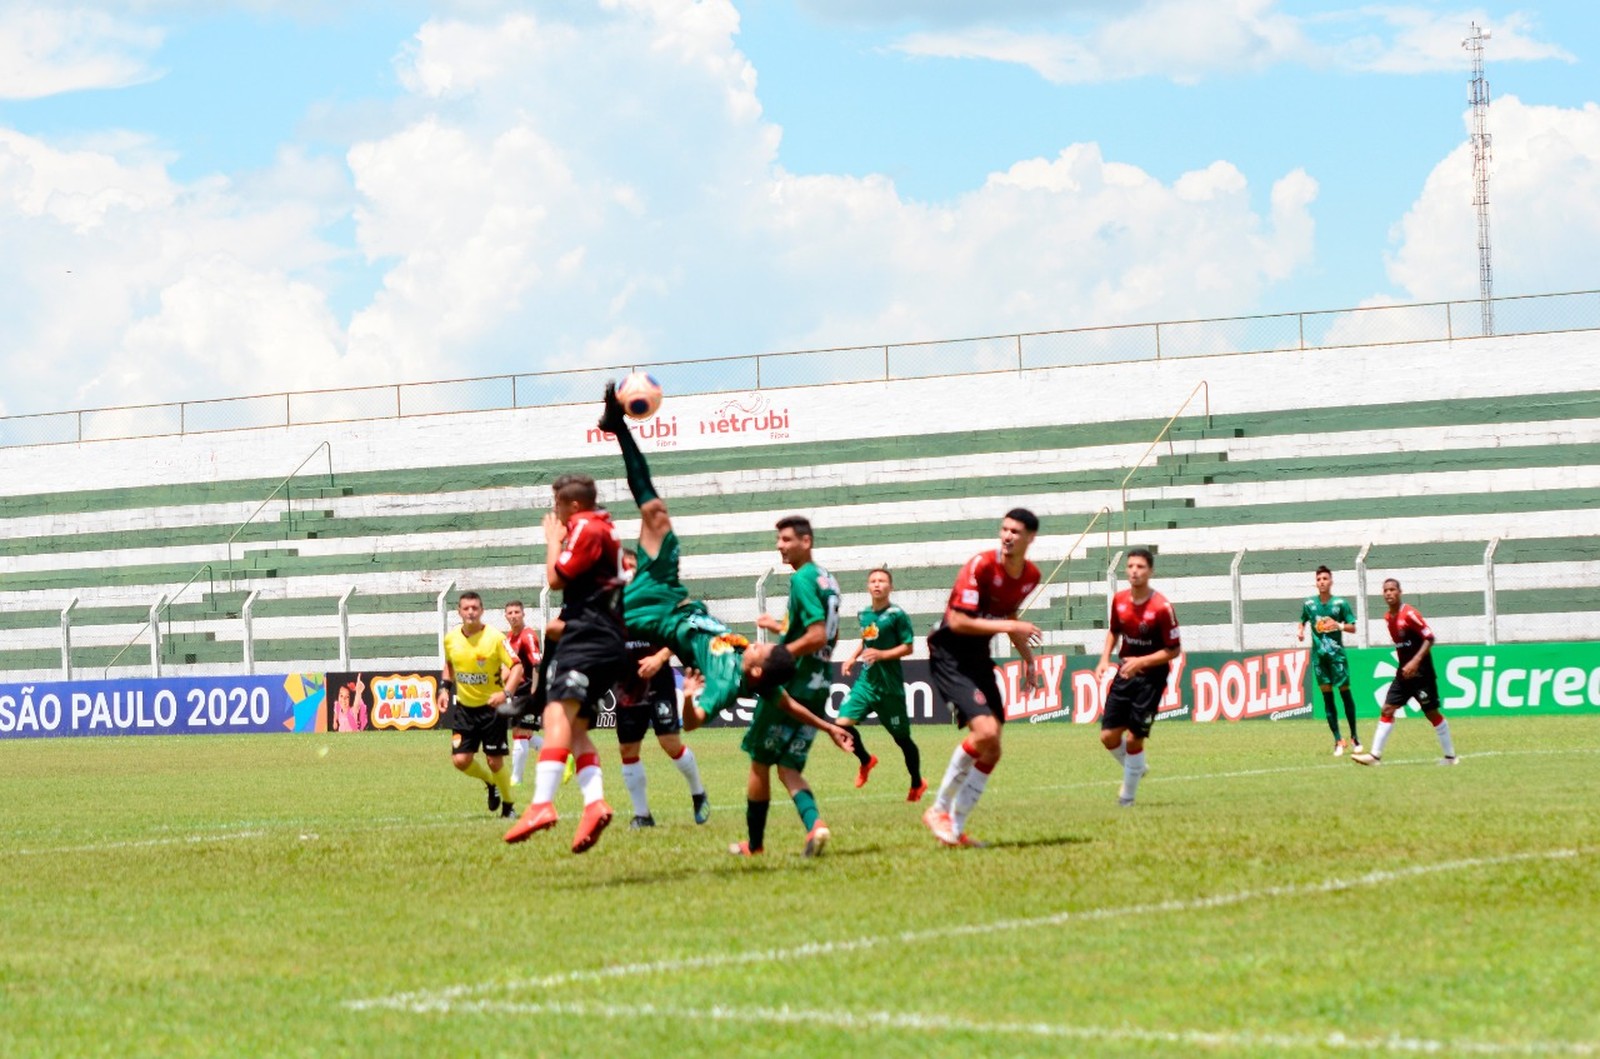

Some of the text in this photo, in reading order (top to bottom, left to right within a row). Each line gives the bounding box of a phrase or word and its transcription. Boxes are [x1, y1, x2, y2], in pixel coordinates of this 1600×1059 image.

[586, 416, 677, 443] neubi
[699, 408, 789, 434] netrubi
[377, 684, 418, 700] VOLTA
[1192, 648, 1310, 722] DOLLY
[0, 686, 270, 732] SÃO PAULO 2020
[378, 701, 432, 719] AULAS
[1153, 705, 1189, 721] uaraná
